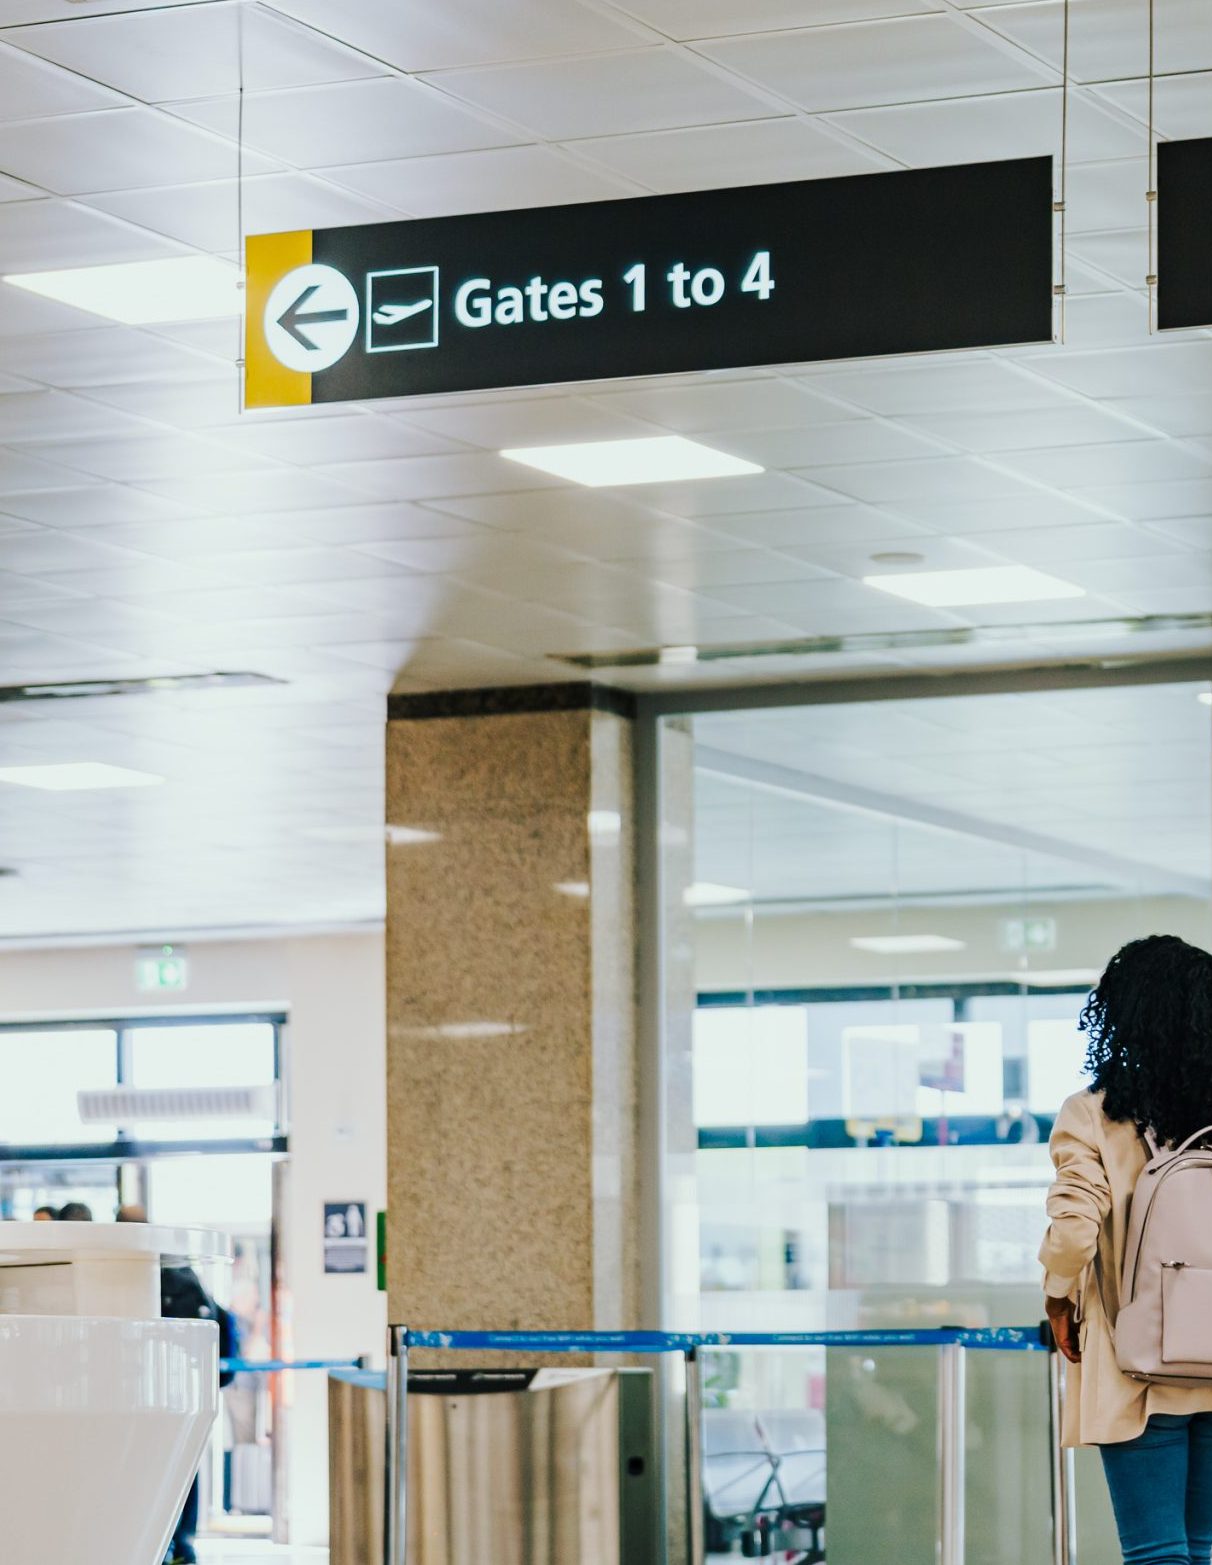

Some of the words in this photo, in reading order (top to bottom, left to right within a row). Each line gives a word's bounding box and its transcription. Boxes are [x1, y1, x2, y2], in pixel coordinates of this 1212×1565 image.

[454, 276, 604, 328] Gates
[622, 263, 646, 312] 1
[666, 262, 725, 309] to
[740, 251, 775, 300] 4
